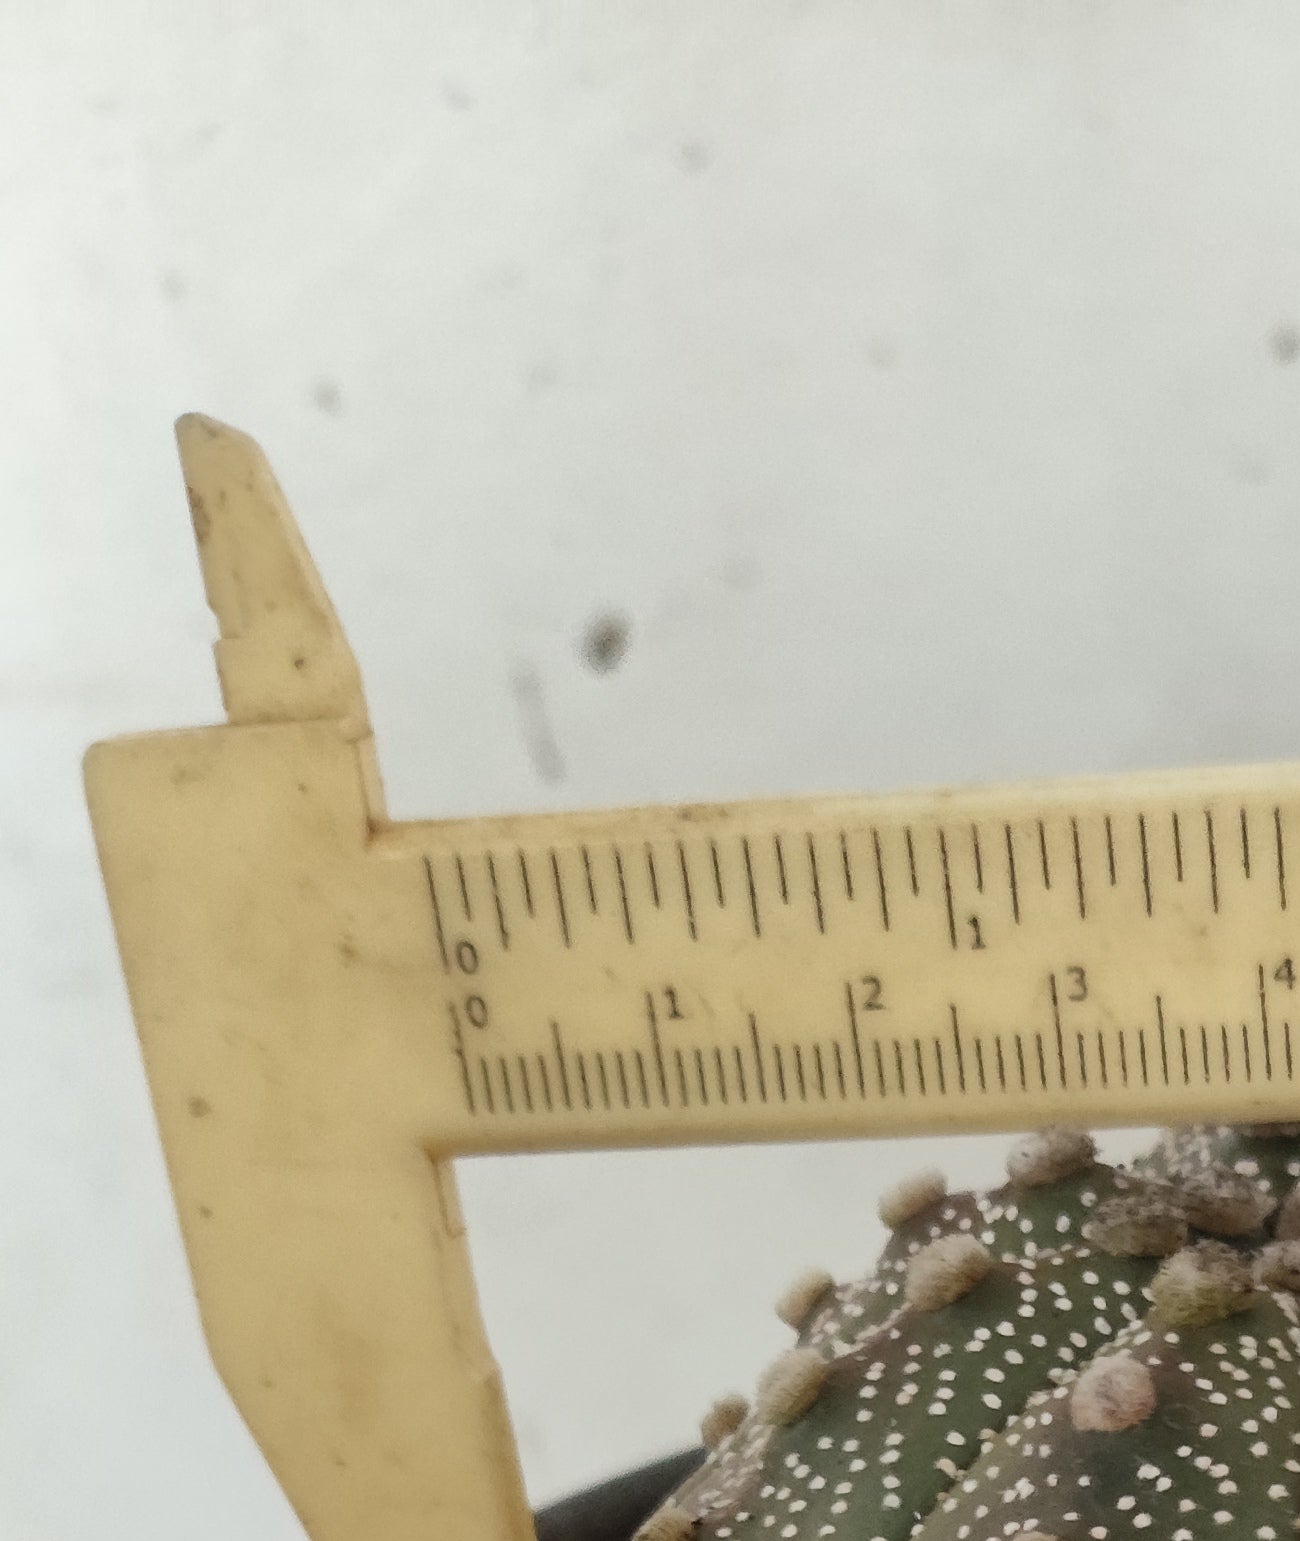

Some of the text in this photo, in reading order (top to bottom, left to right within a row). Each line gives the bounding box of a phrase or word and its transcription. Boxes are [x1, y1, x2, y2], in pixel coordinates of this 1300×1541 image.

[456, 939, 479, 975] 0
[966, 914, 986, 950] 1
[464, 994, 488, 1029] 0
[664, 985, 684, 1020] 1
[862, 976, 884, 1011] 2
[1066, 966, 1088, 1001] 3
[1273, 958, 1296, 990] 4
